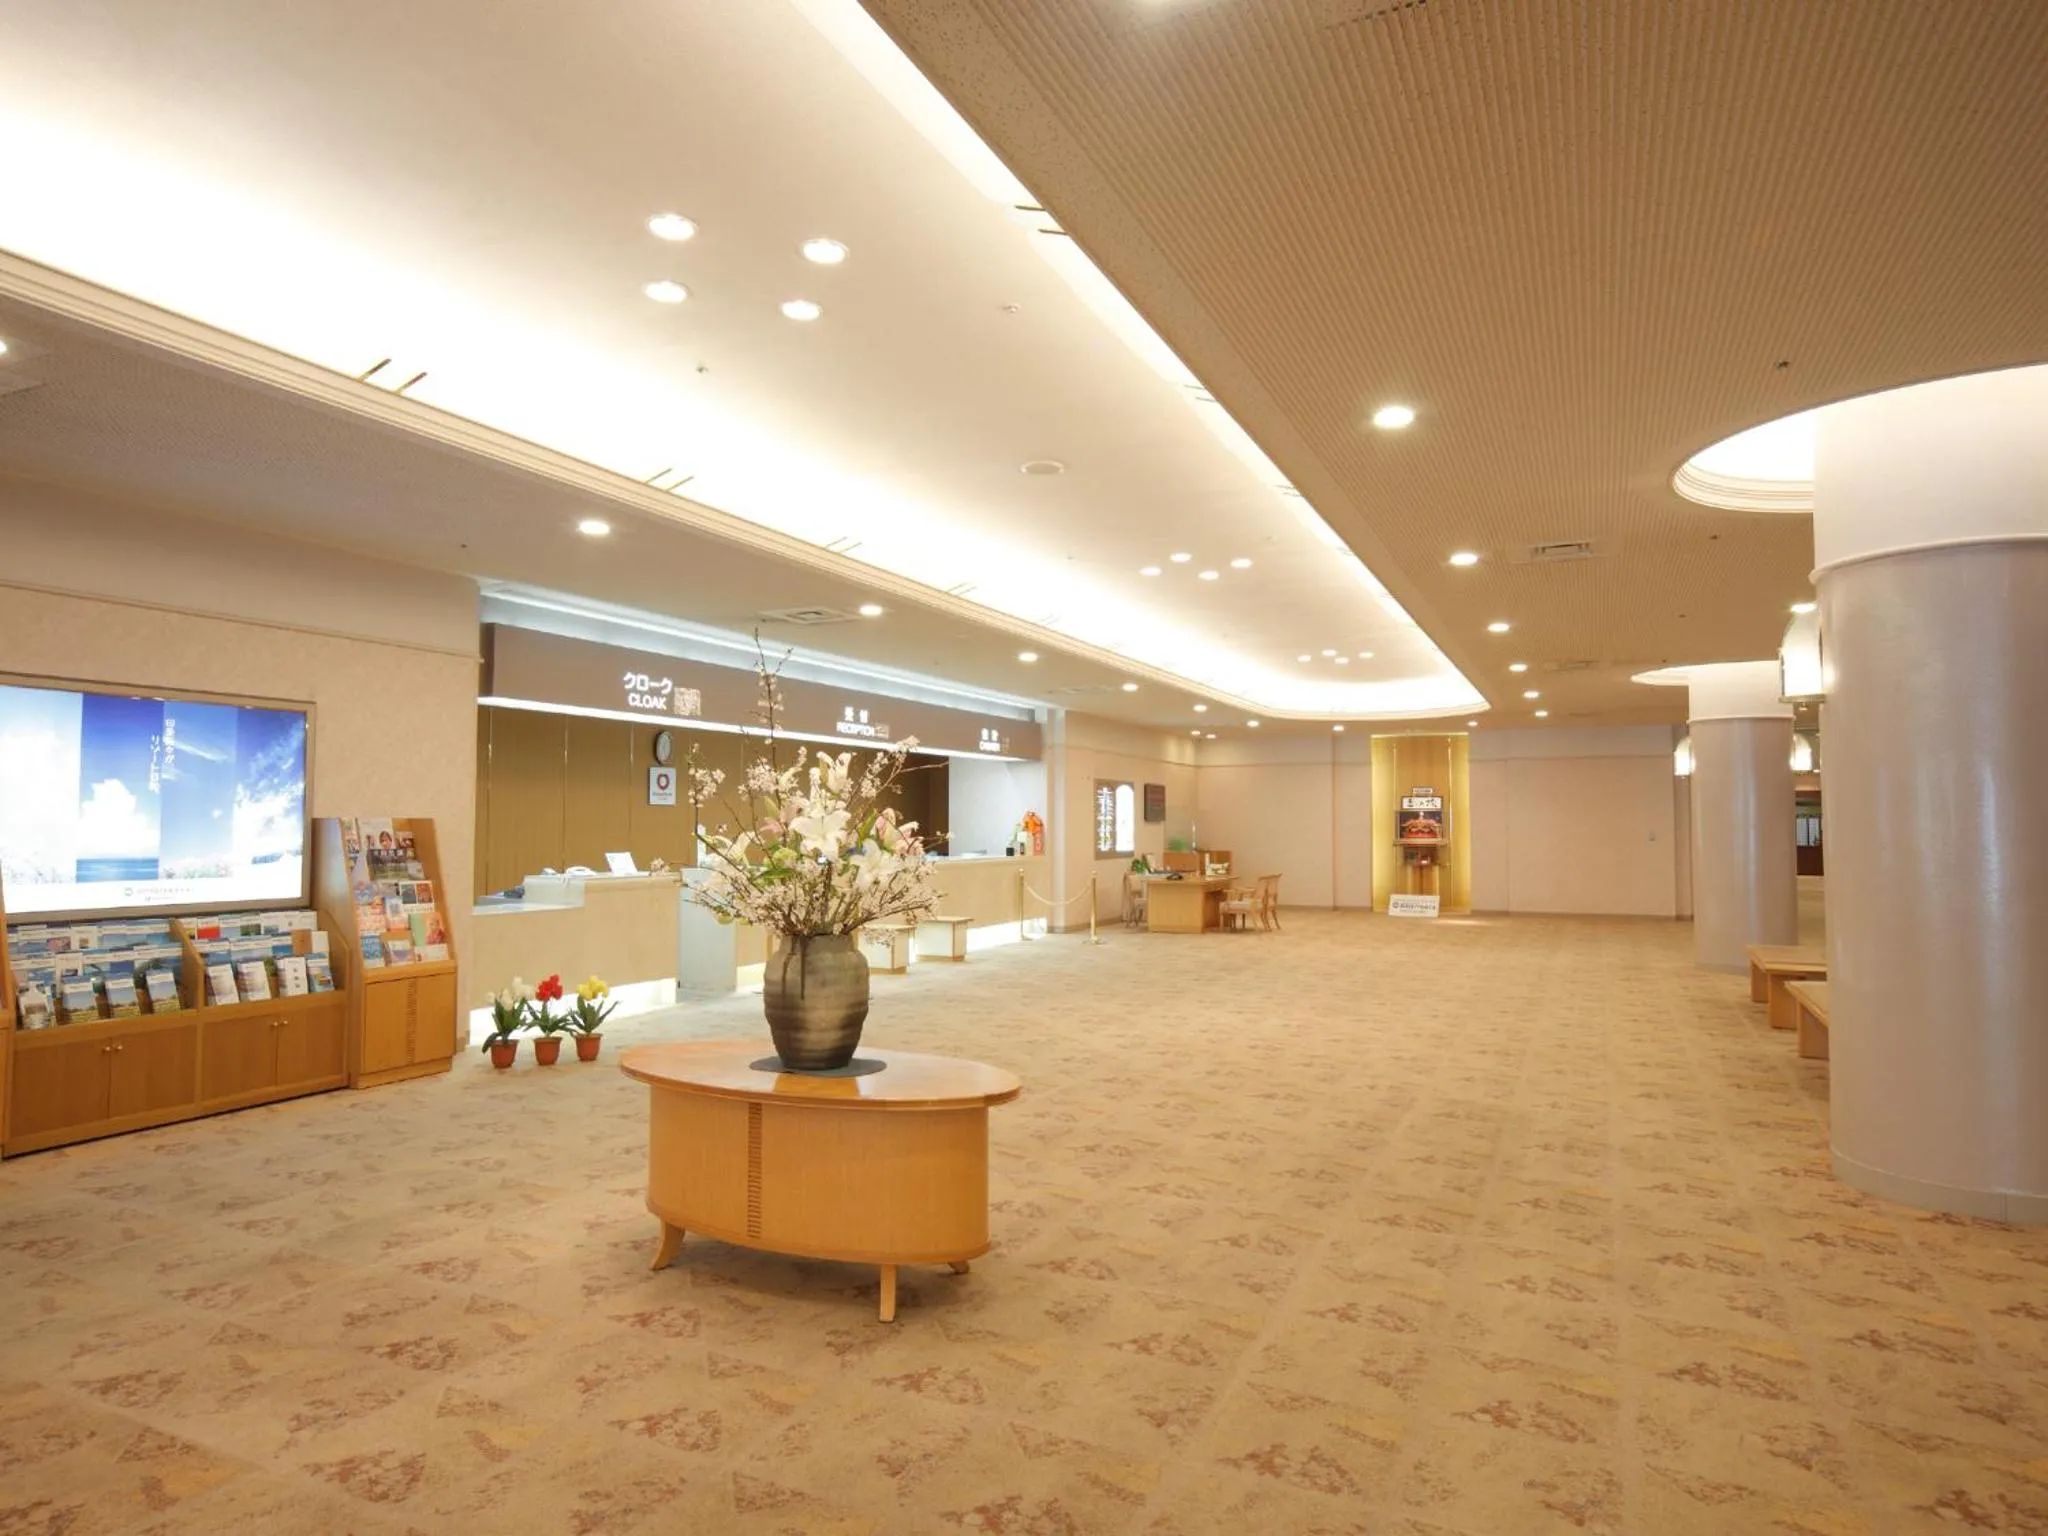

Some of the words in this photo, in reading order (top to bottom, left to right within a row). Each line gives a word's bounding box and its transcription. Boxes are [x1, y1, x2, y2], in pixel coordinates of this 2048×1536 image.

[623, 672, 673, 694] クローク
[628, 692, 667, 710] CLOAK
